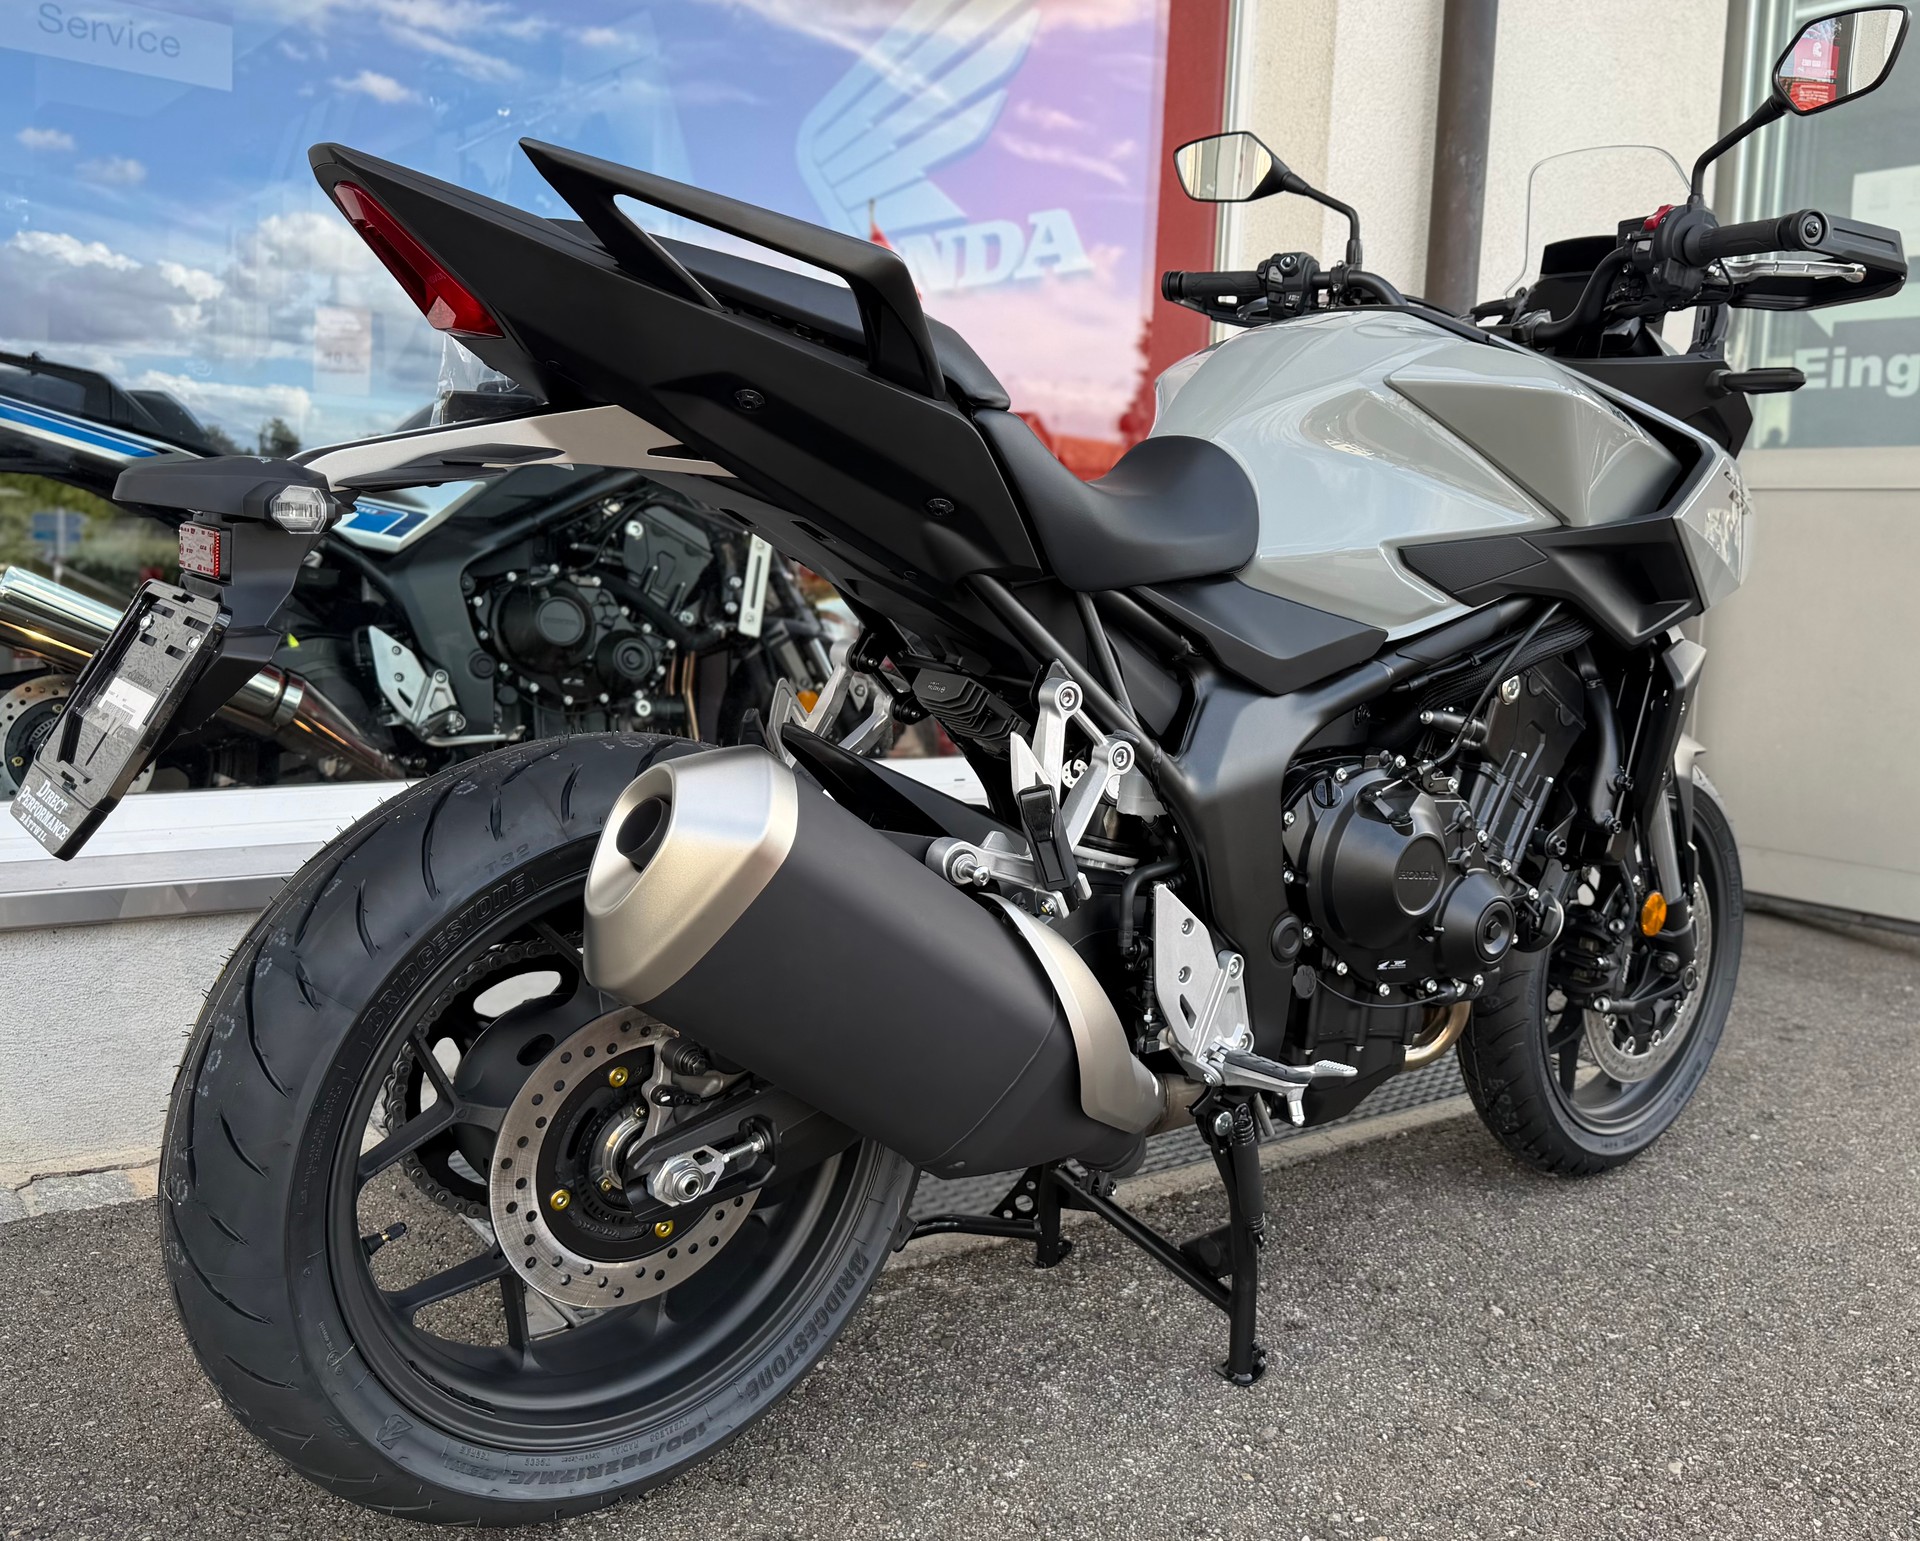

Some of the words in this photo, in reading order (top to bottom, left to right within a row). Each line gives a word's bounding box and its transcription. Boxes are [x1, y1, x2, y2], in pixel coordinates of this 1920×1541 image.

[38, 2, 181, 58] Service
[897, 207, 1096, 292] NDA
[17, 784, 70, 841] PERFORMANCE
[36, 779, 69, 814] DIRECT
[484, 843, 531, 876] T32
[361, 872, 526, 1038] BRIDGESTONE
[743, 1246, 870, 1404] BRIDGESTONE
